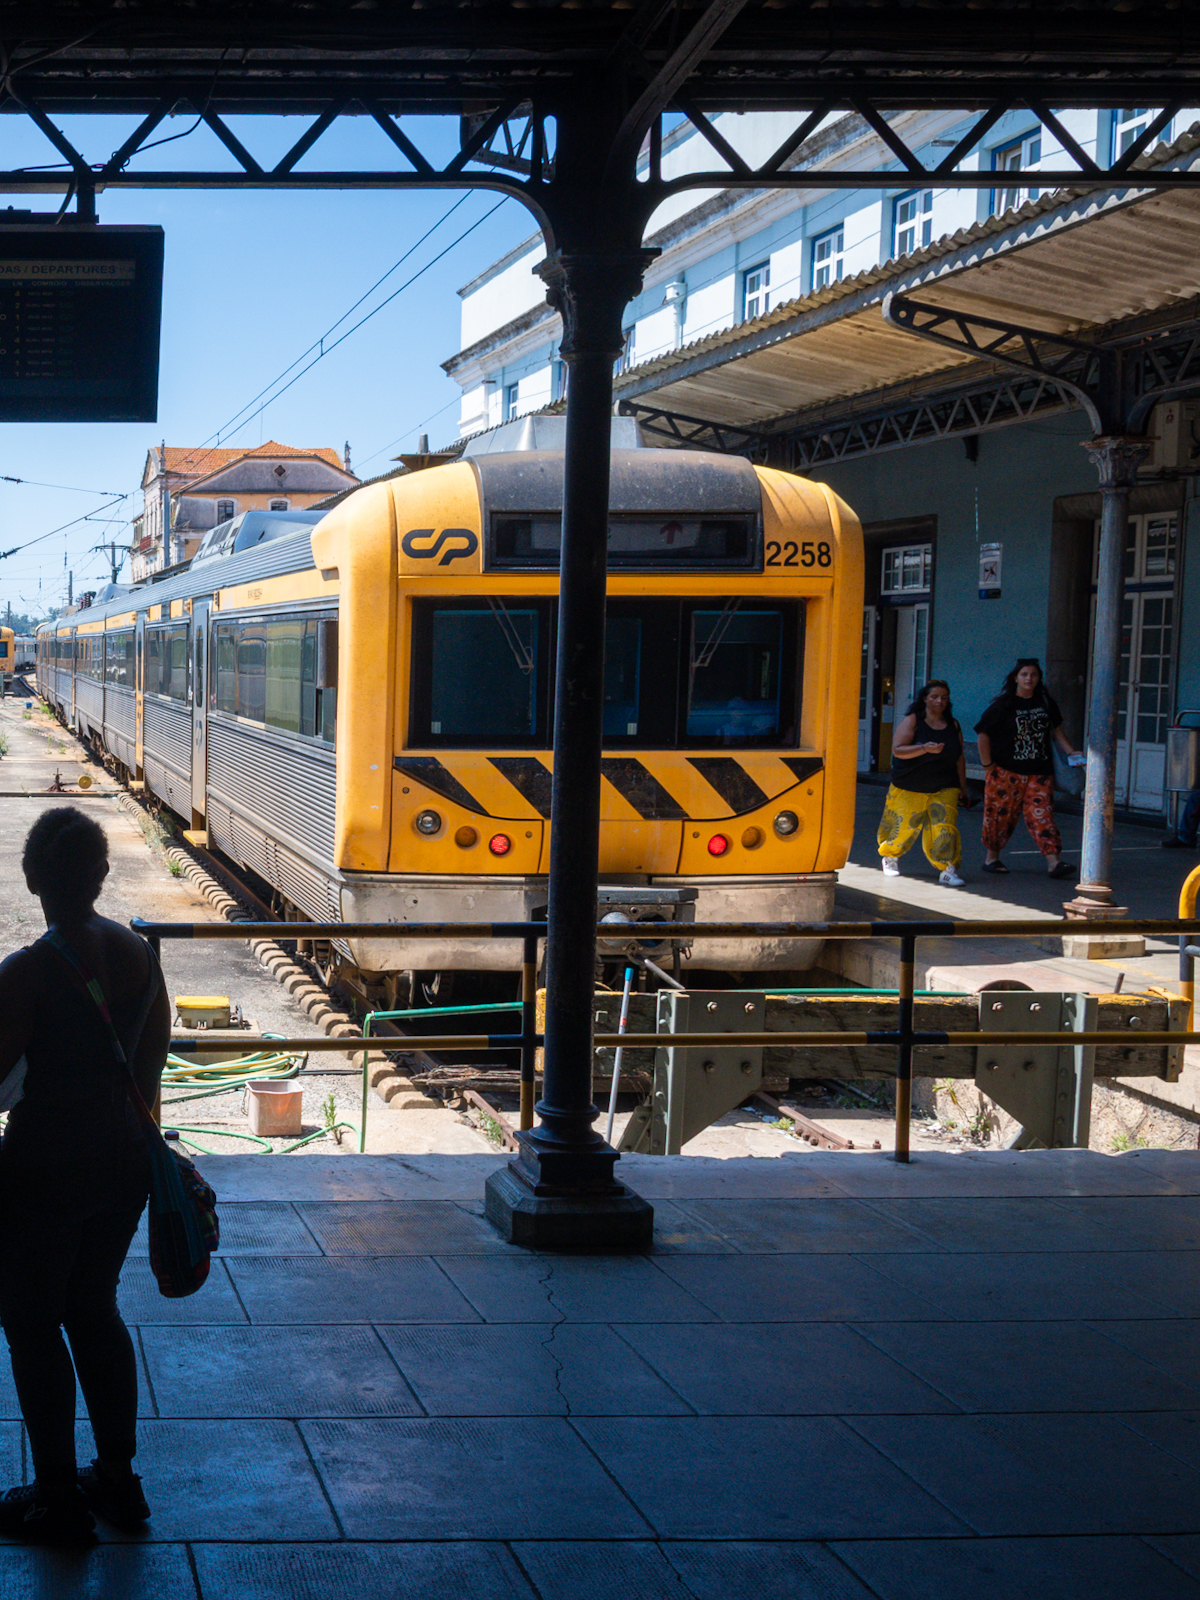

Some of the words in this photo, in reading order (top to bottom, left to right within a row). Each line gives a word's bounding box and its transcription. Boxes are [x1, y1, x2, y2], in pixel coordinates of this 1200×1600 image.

[31, 264, 116, 274] DEPARTURES
[402, 528, 478, 566] CP
[765, 541, 831, 567] 2258
